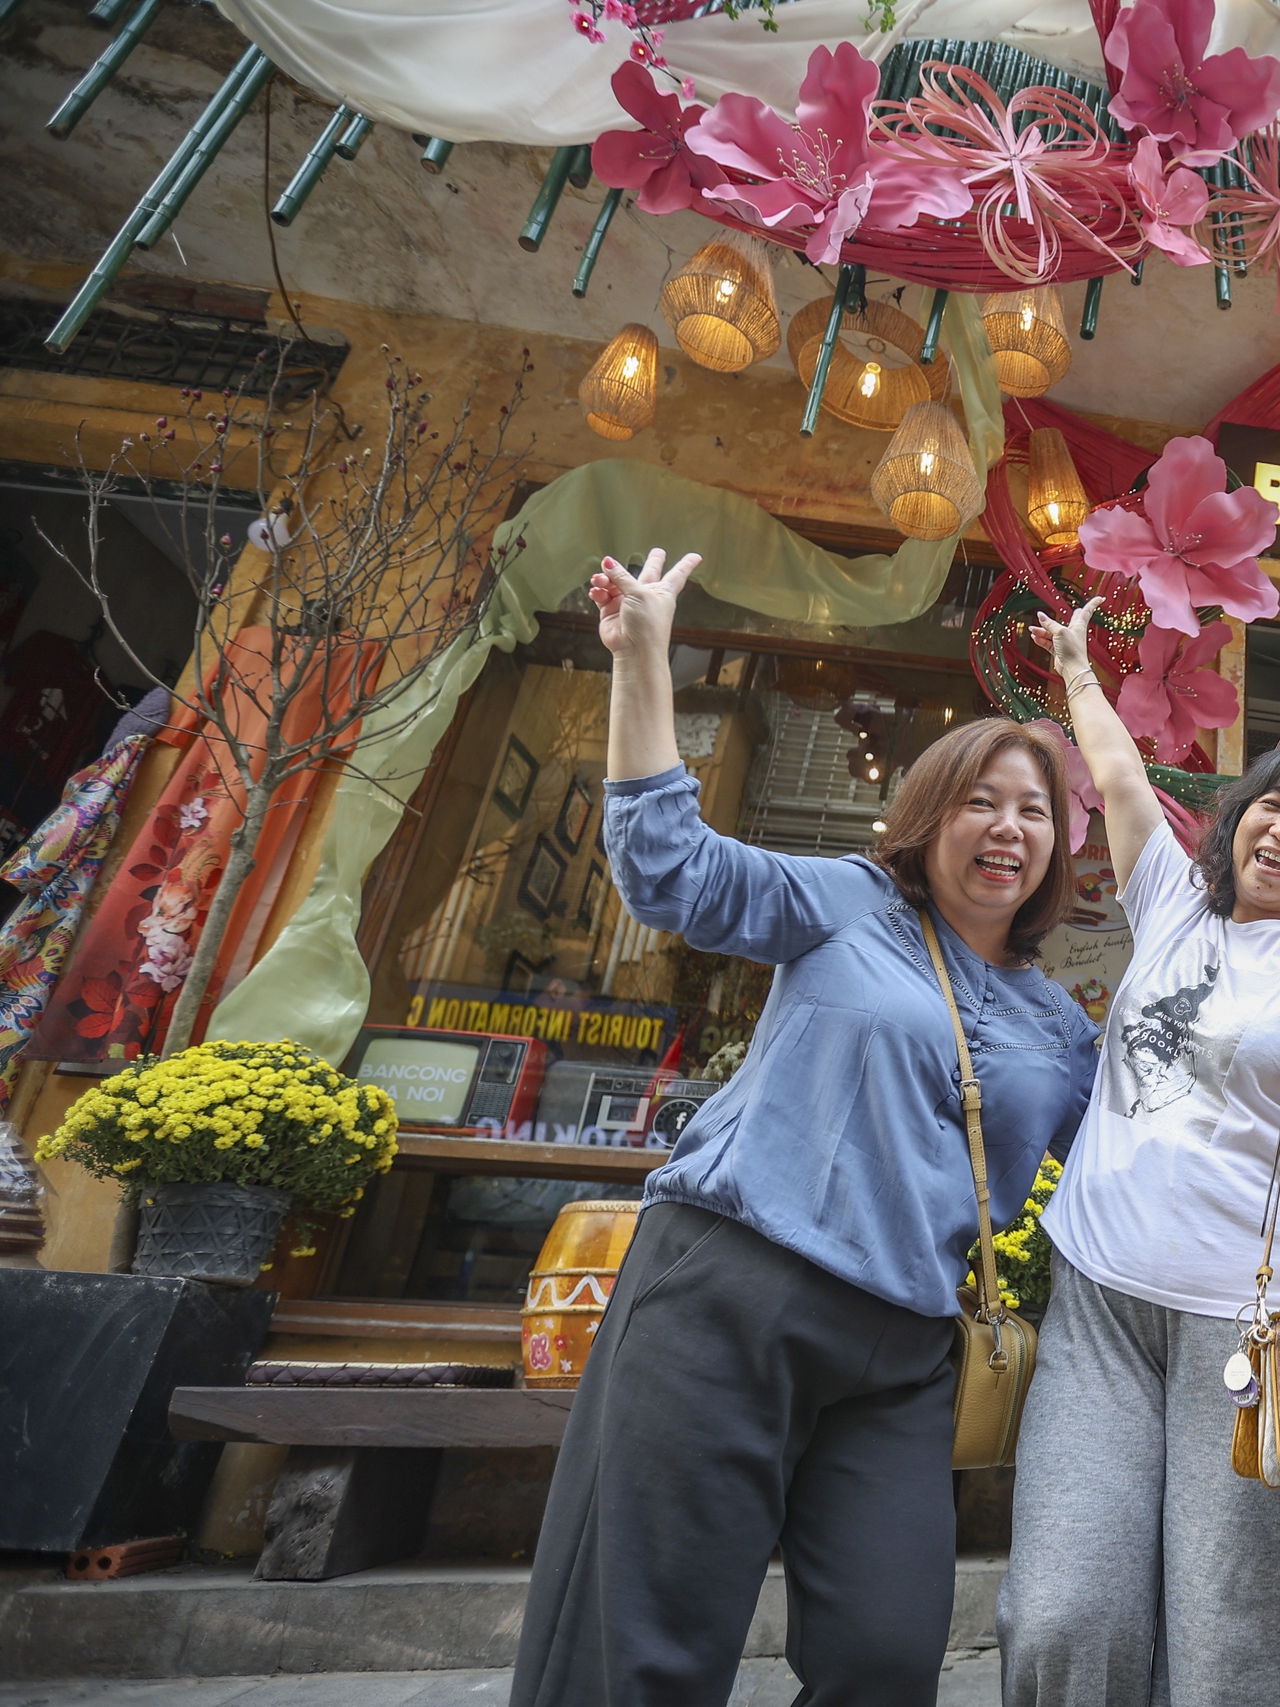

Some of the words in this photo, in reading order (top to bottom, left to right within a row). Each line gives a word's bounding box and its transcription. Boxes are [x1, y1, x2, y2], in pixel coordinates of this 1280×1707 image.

[1069, 940, 1099, 959] English
[1043, 961, 1055, 978] Egg
[1060, 952, 1105, 969] Benedict
